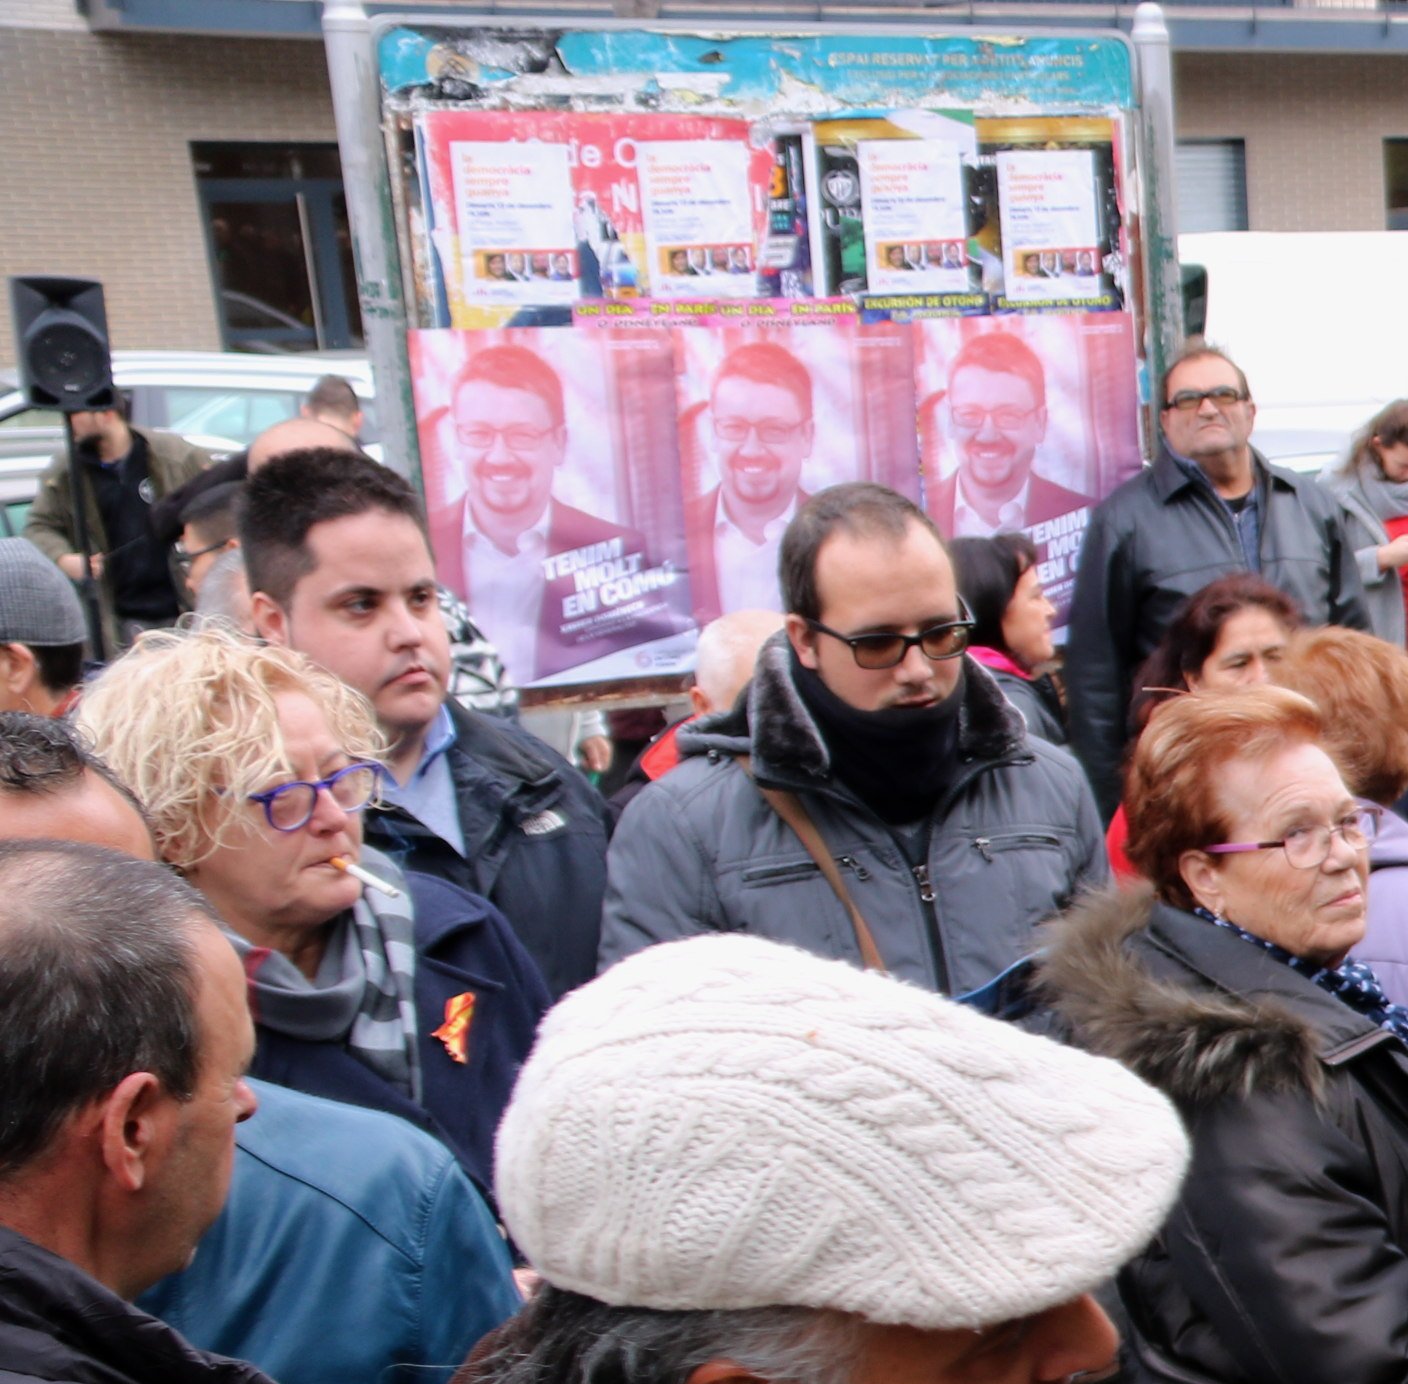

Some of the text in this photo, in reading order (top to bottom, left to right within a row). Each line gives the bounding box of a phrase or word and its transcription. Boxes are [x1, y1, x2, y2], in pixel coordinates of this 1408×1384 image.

[541, 536, 624, 581] TENIM
[1047, 530, 1083, 561] MO
[562, 559, 678, 619] EN COMÚ
[573, 552, 642, 592] MOLT
[1036, 557, 1066, 584] EN
